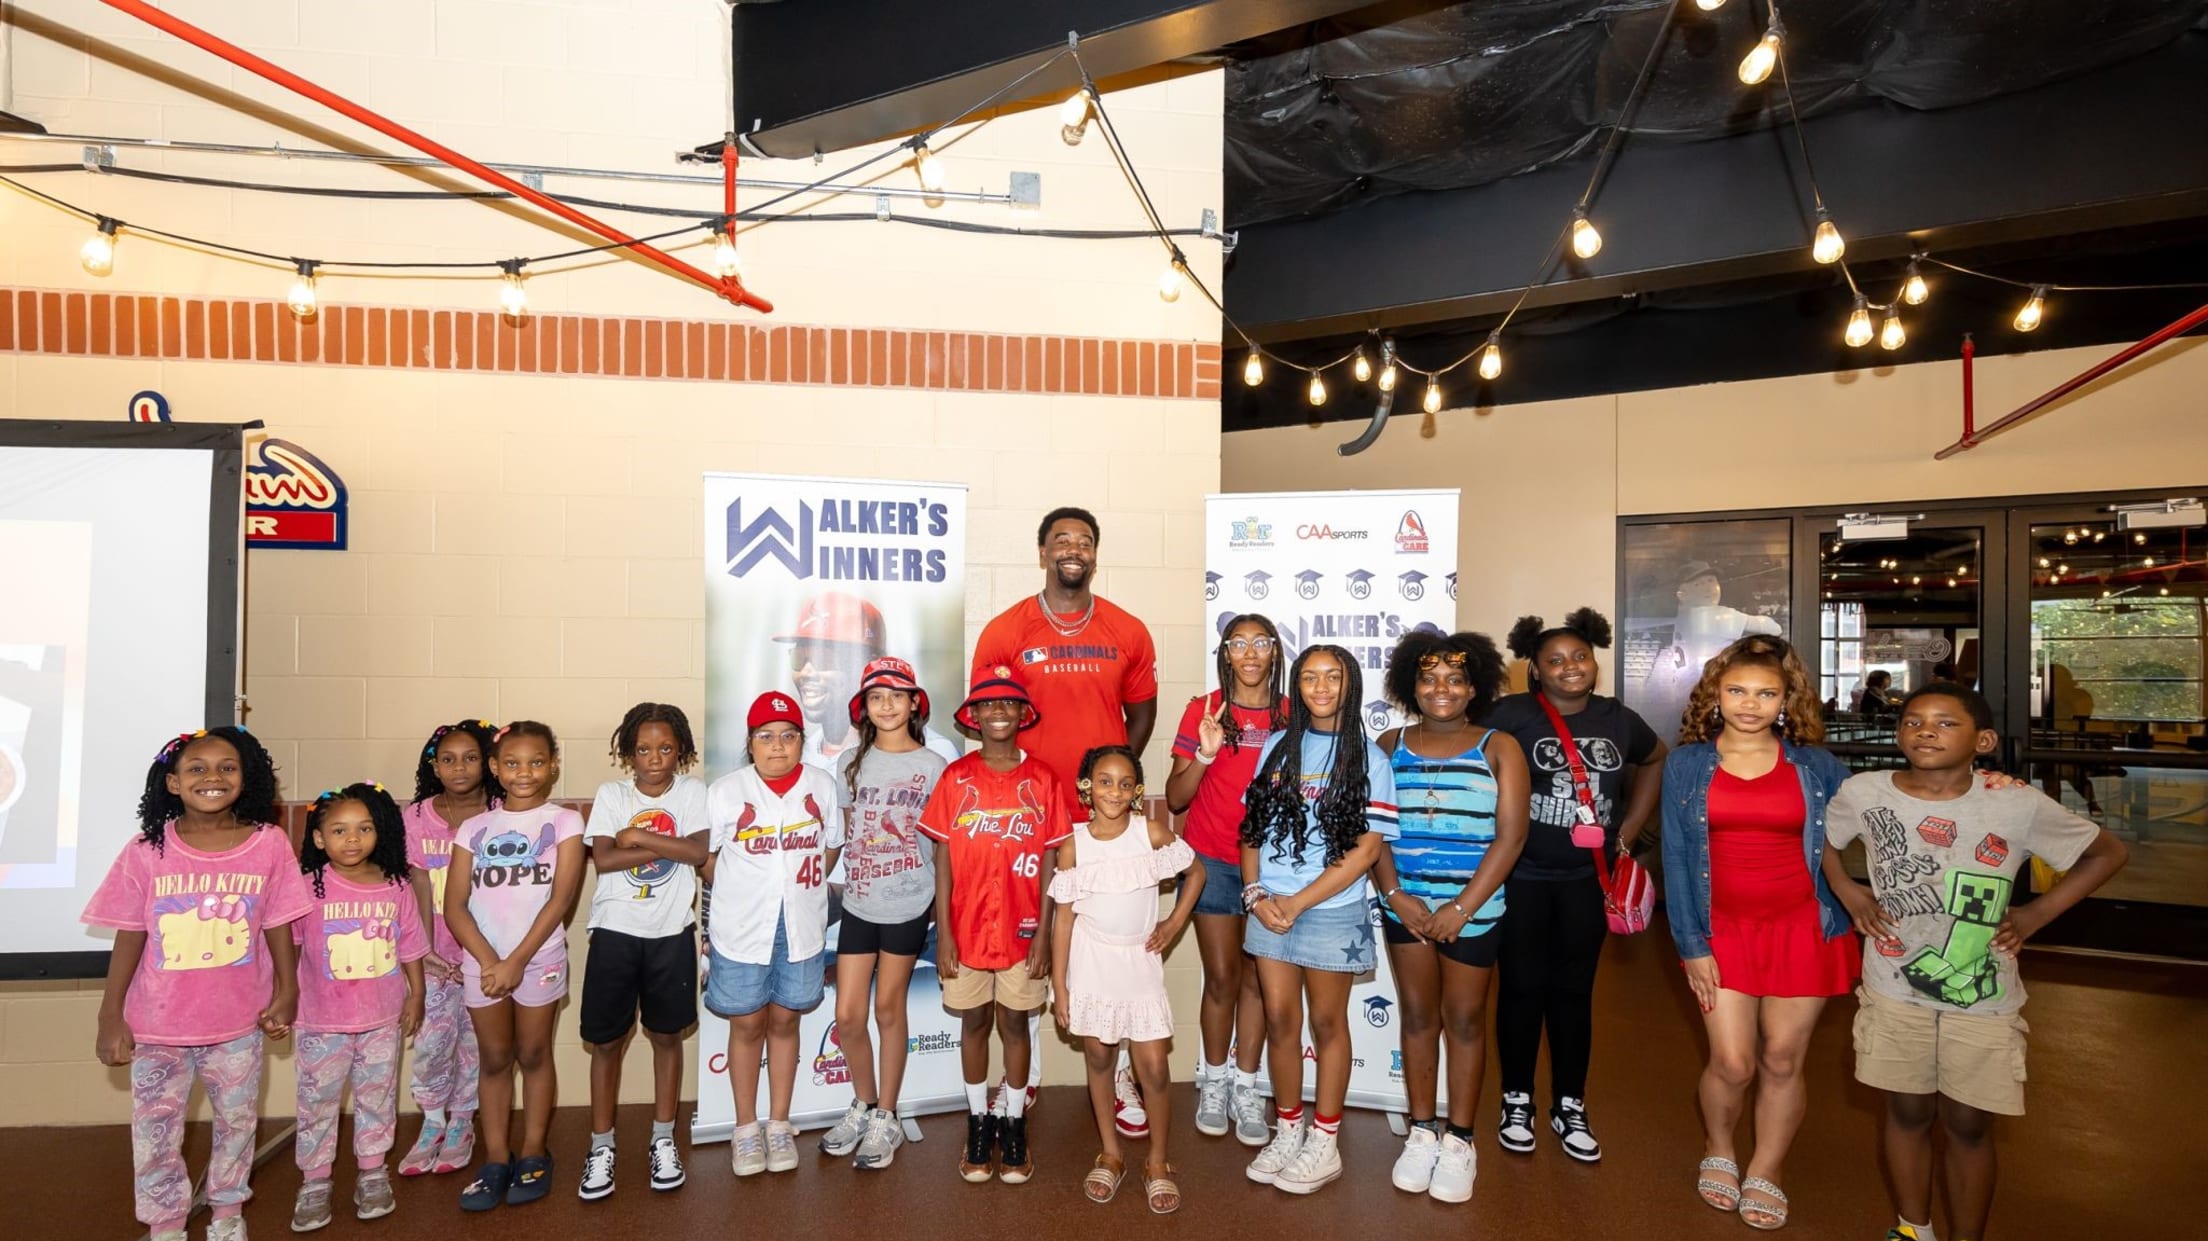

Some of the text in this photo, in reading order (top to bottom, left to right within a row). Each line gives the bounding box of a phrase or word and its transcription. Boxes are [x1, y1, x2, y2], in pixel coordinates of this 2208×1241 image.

[1050, 646, 1118, 660] CARDINALS
[1044, 663, 1101, 674] BASEBALL
[965, 810, 1034, 842] The Lou
[796, 854, 822, 889] 46
[1012, 852, 1040, 879] 46
[154, 872, 268, 897] HELLO KITTY
[323, 902, 372, 921] HELLO
[918, 1031, 952, 1043] Ready
[918, 1039, 962, 1052] Readers
